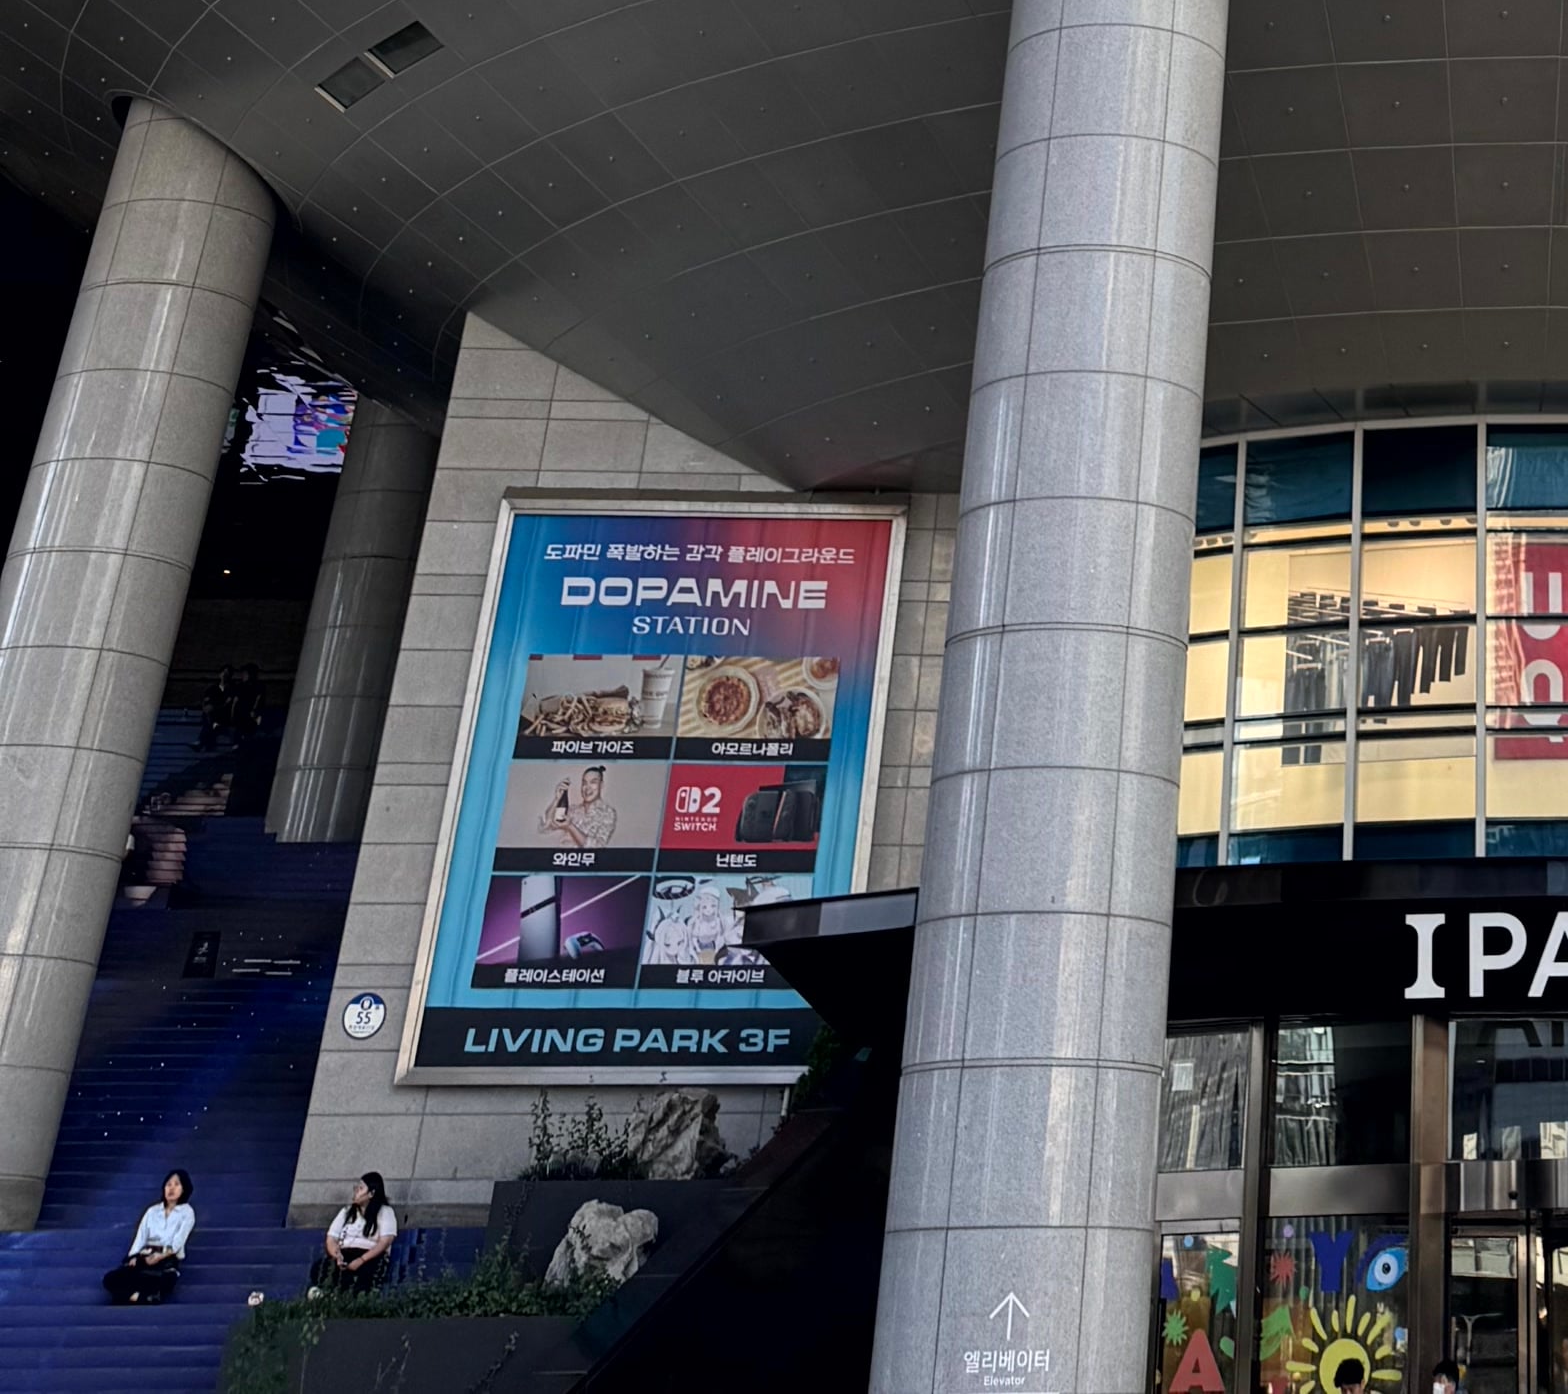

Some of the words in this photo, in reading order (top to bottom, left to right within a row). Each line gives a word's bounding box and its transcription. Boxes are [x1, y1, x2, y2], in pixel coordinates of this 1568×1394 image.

[544, 544, 601, 560] 도파민
[606, 544, 680, 561] 폭발하는
[685, 544, 722, 561] 감각
[727, 546, 855, 564] 플레이그라운드
[560, 576, 828, 609] DOPAMINE
[632, 616, 751, 636] STATION
[701, 786, 722, 813] 2
[674, 821, 717, 832] SWITCH
[552, 853, 595, 867] 와인무
[716, 853, 757, 868] 닌텐도
[504, 968, 605, 984] 플레이스테이션
[676, 969, 704, 984] 블루
[708, 969, 764, 984] 아카이브
[355, 1011, 372, 1025] 55
[464, 1028, 605, 1053] LIVING
[613, 1028, 730, 1054] PARK
[738, 1028, 791, 1054] 3F
[963, 1348, 1051, 1373] 엘리베이터
[983, 1374, 1026, 1386] Elevator
